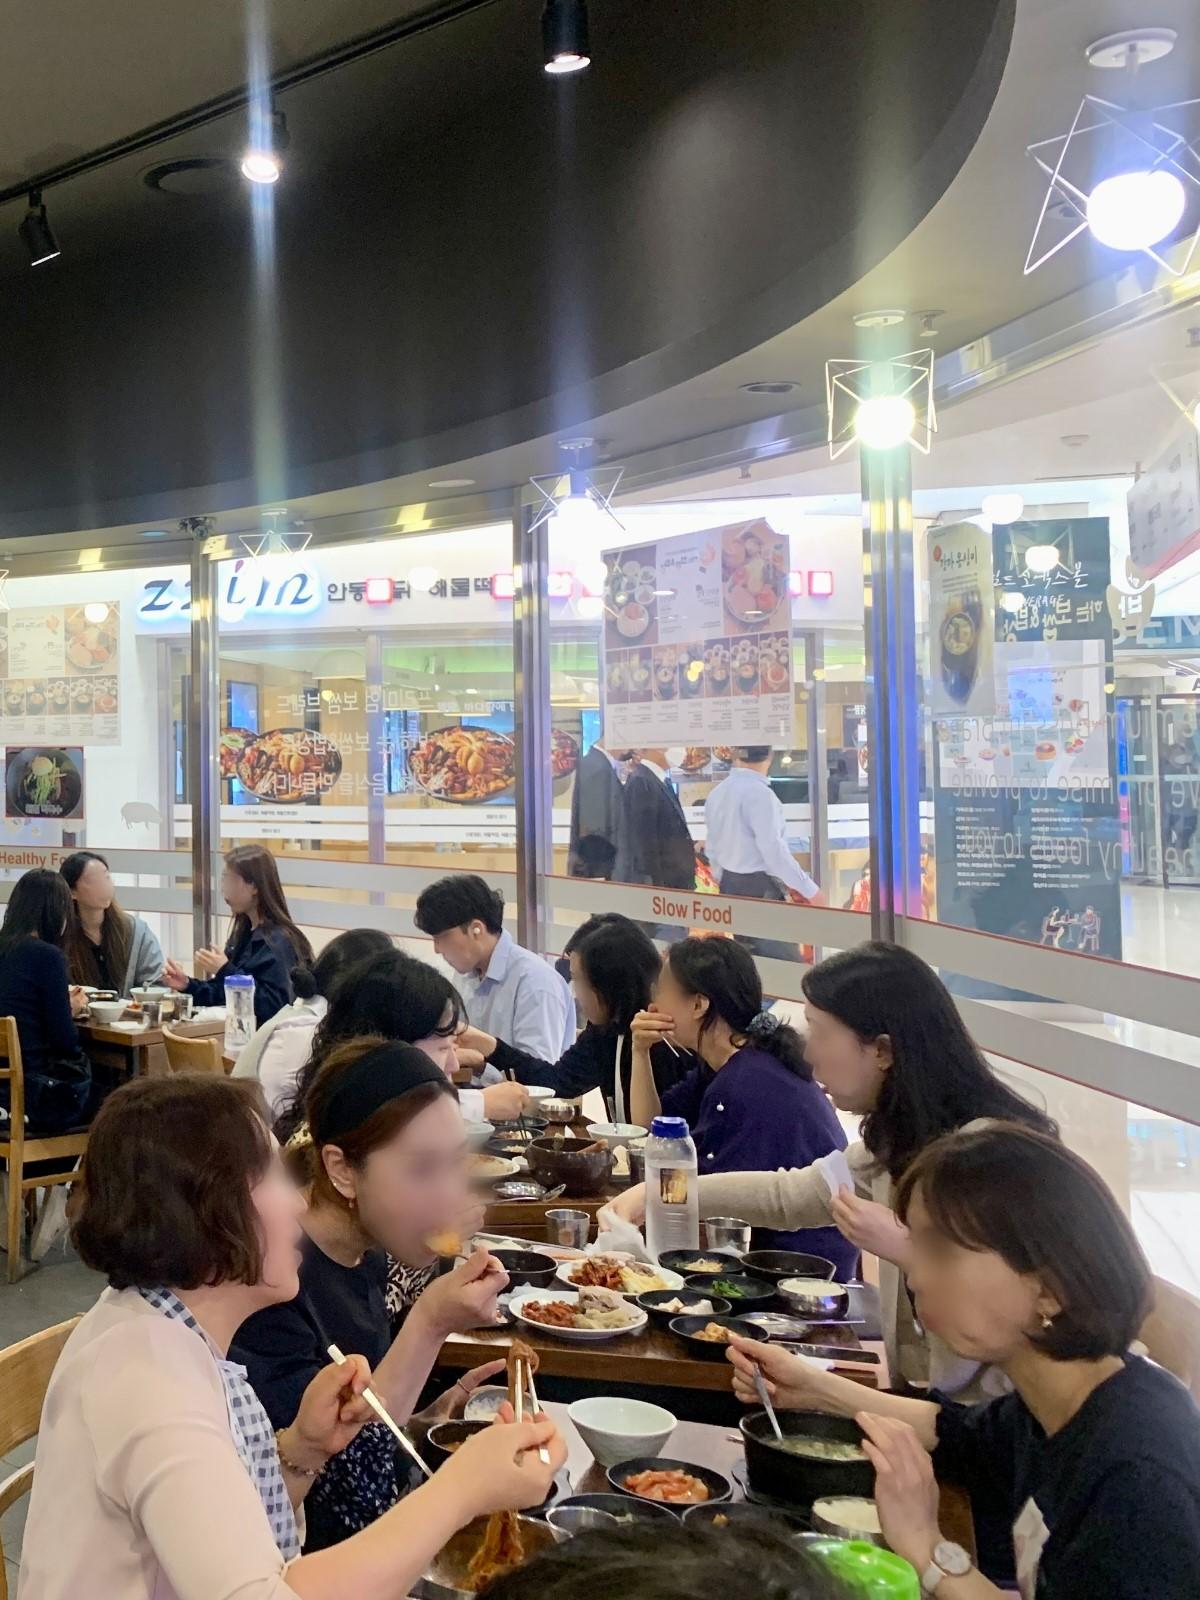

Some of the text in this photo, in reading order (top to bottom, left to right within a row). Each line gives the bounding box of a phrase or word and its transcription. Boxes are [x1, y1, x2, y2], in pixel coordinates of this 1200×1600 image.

[51, 853, 66, 866] Fo
[652, 895, 733, 925] Slow Food
